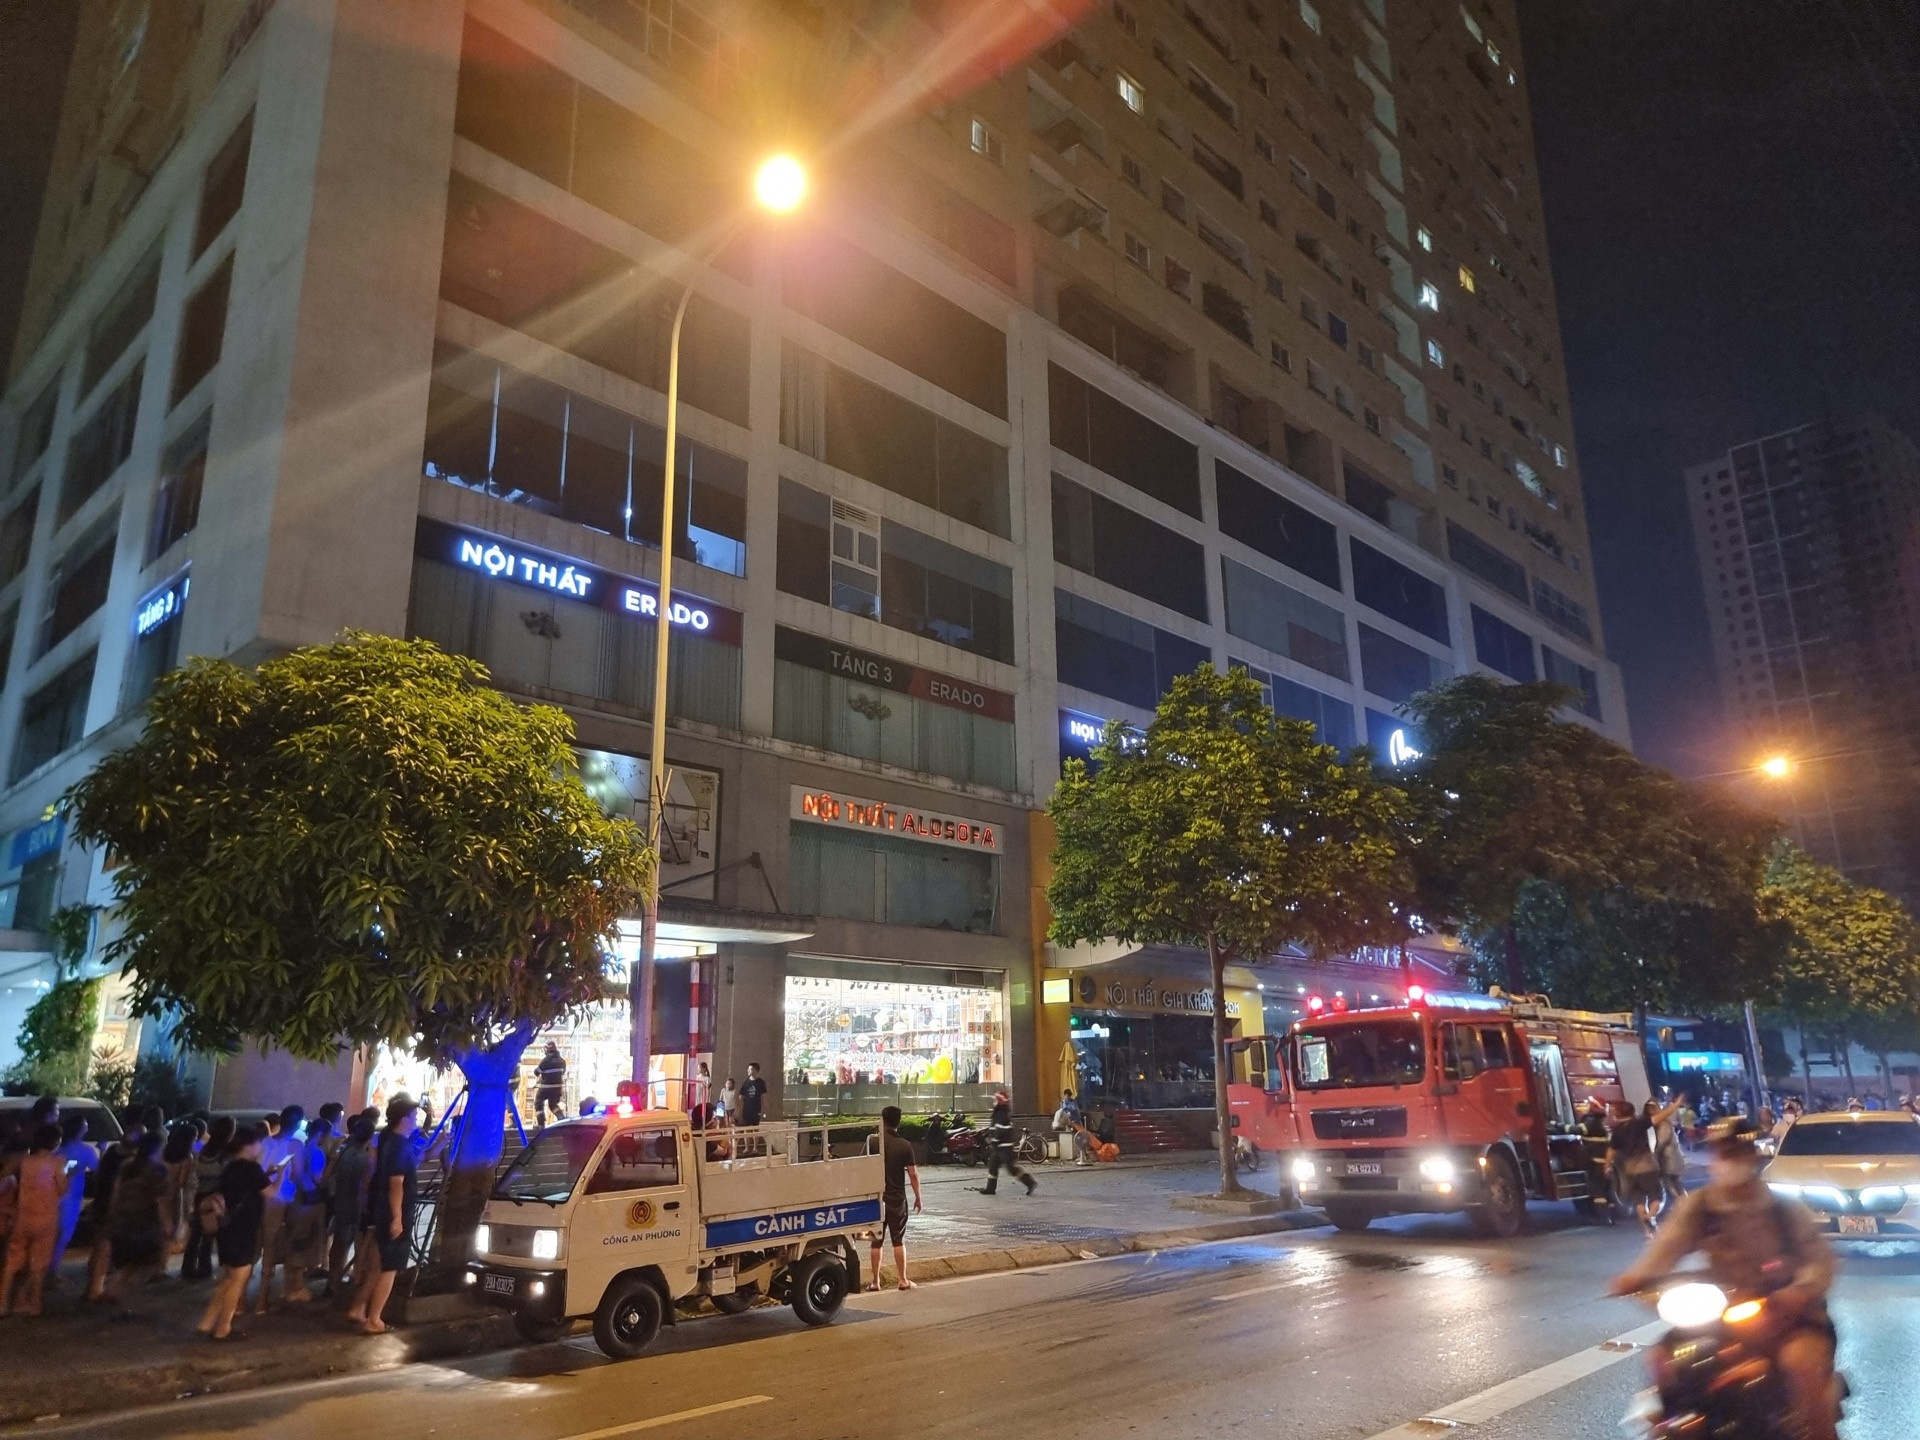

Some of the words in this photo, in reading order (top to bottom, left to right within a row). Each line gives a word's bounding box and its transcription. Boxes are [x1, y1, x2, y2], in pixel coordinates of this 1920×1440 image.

[461, 540, 515, 576] NỘI
[521, 557, 592, 596] THẤT
[883, 666, 893, 683] 3
[930, 679, 985, 708] ERADO
[803, 793, 840, 822] NỘI
[845, 801, 897, 830] THẤT
[901, 812, 995, 848] ALOSOFA
[1162, 990, 1184, 1008] GIA
[754, 1214, 805, 1236] CẢNH
[815, 1207, 848, 1226] SÁT
[631, 1234, 643, 1242] AN
